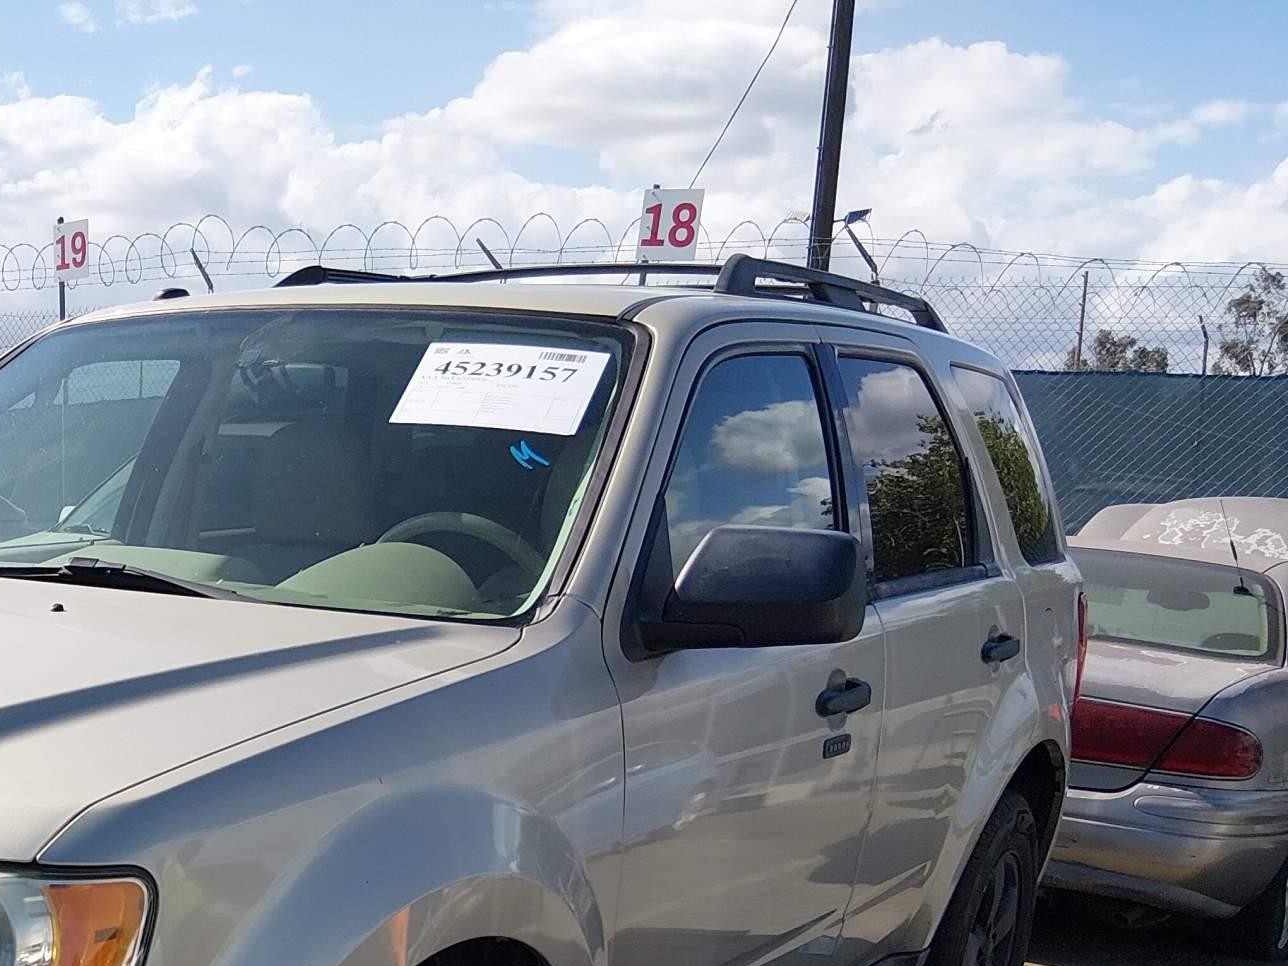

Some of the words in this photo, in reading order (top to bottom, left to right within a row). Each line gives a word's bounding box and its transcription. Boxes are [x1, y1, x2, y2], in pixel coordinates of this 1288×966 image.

[641, 202, 697, 248] 18
[55, 230, 87, 271] 19
[434, 360, 579, 383] 45239157
